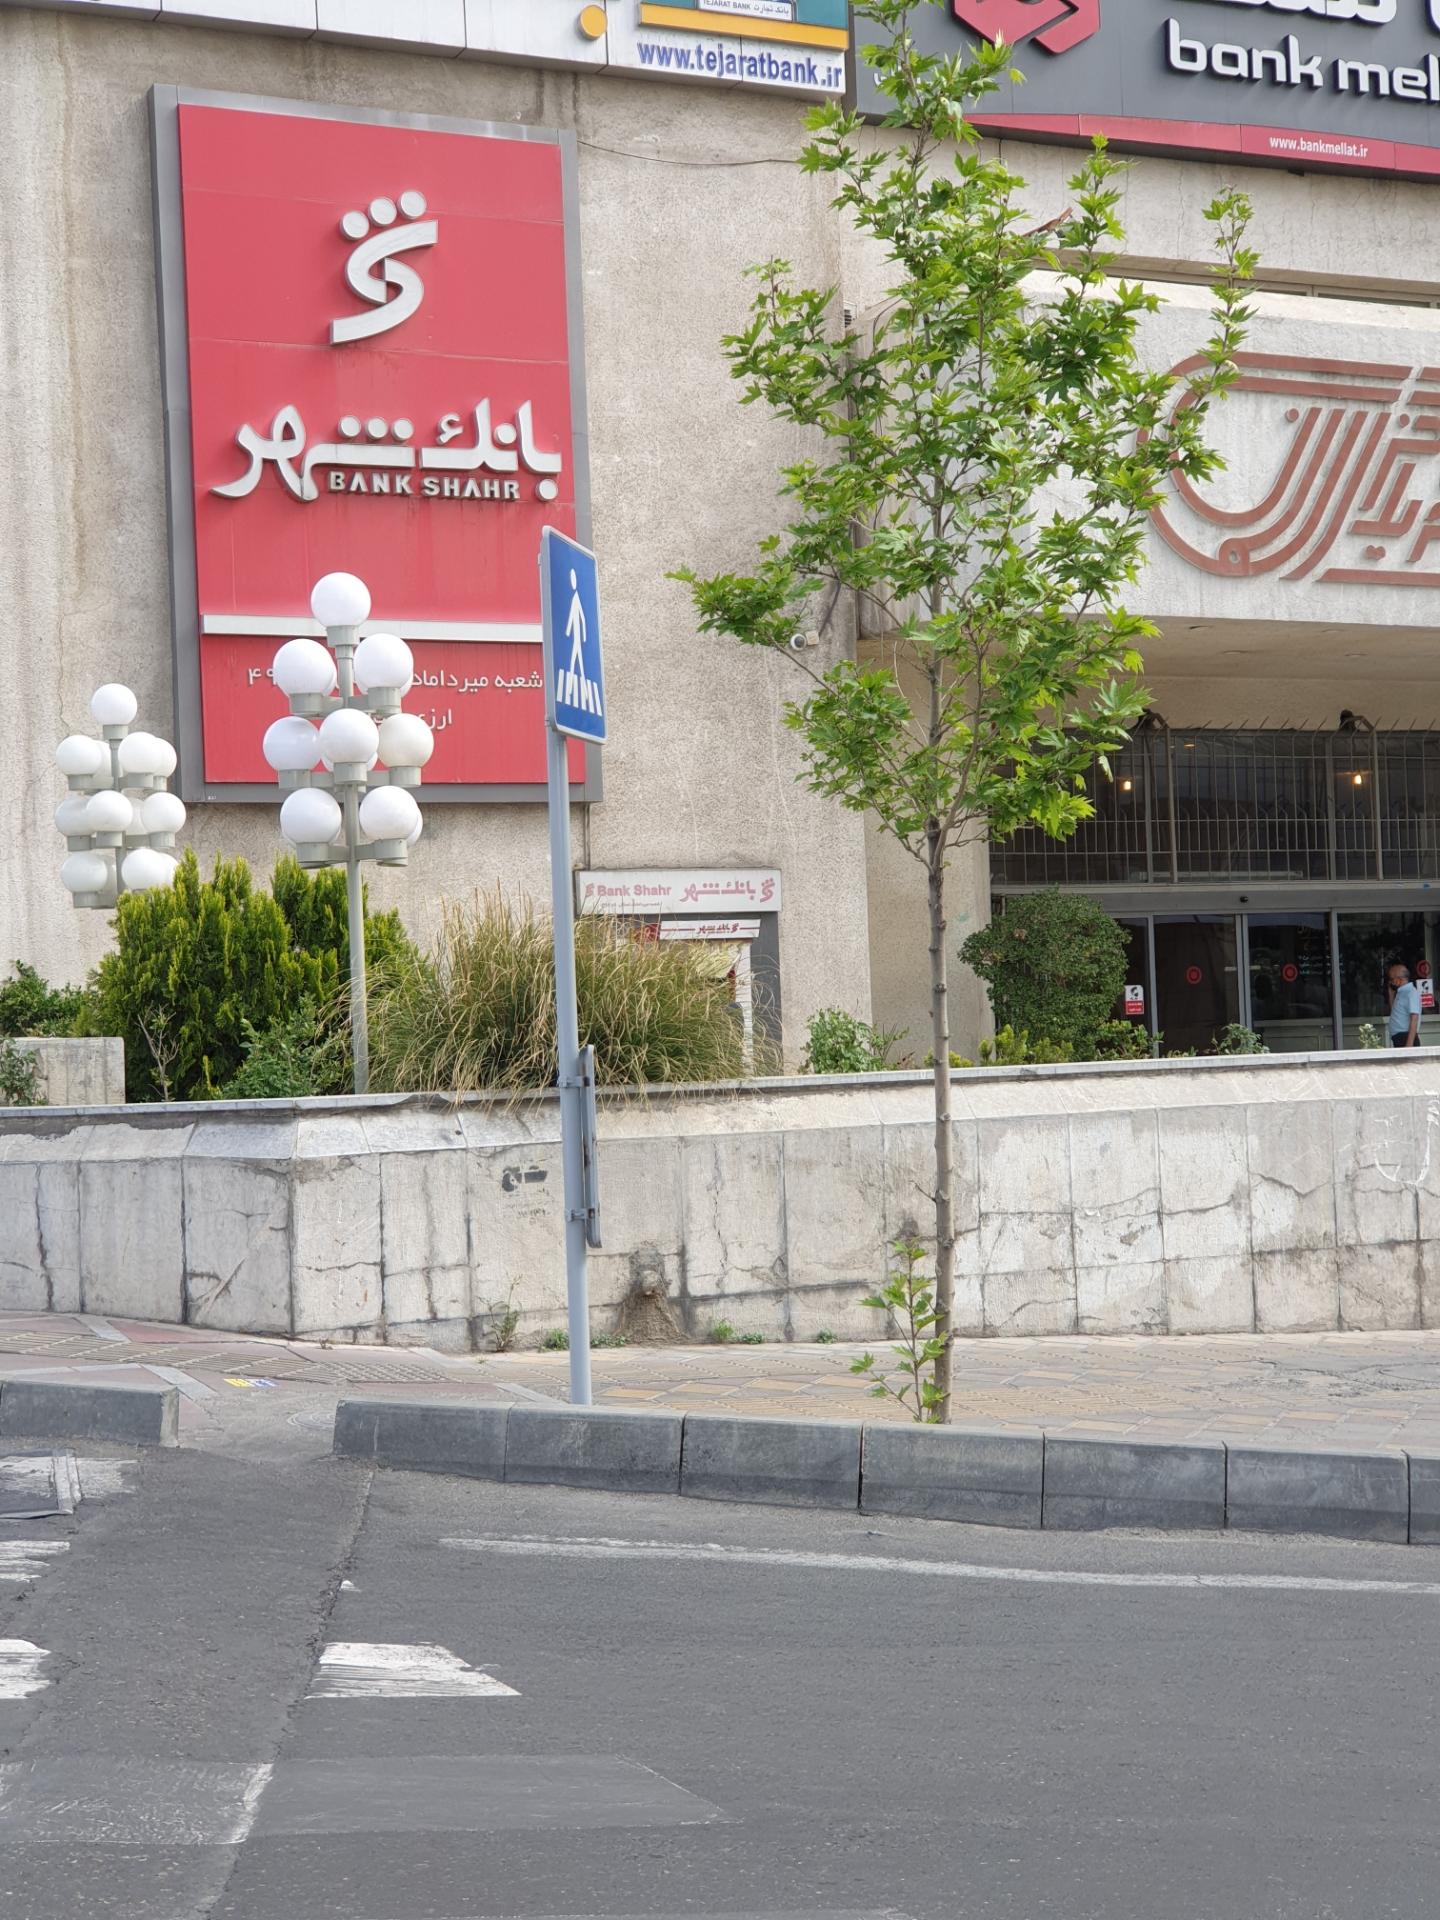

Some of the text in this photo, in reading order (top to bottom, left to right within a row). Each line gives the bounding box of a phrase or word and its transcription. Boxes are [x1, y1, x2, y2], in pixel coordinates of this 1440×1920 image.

[733, 2, 751, 10] BANK
[637, 41, 843, 88] www.tejaratbank.ir
[1164, 17, 1324, 88] bank
[1268, 136, 1369, 158] www.bankmellat.ir
[210, 404, 417, 503] شهر
[329, 470, 521, 500] BANK SHAHR
[494, 670, 544, 694] شعبه
[597, 883, 673, 897] Bank Shahr
[680, 883, 720, 902] شهر
